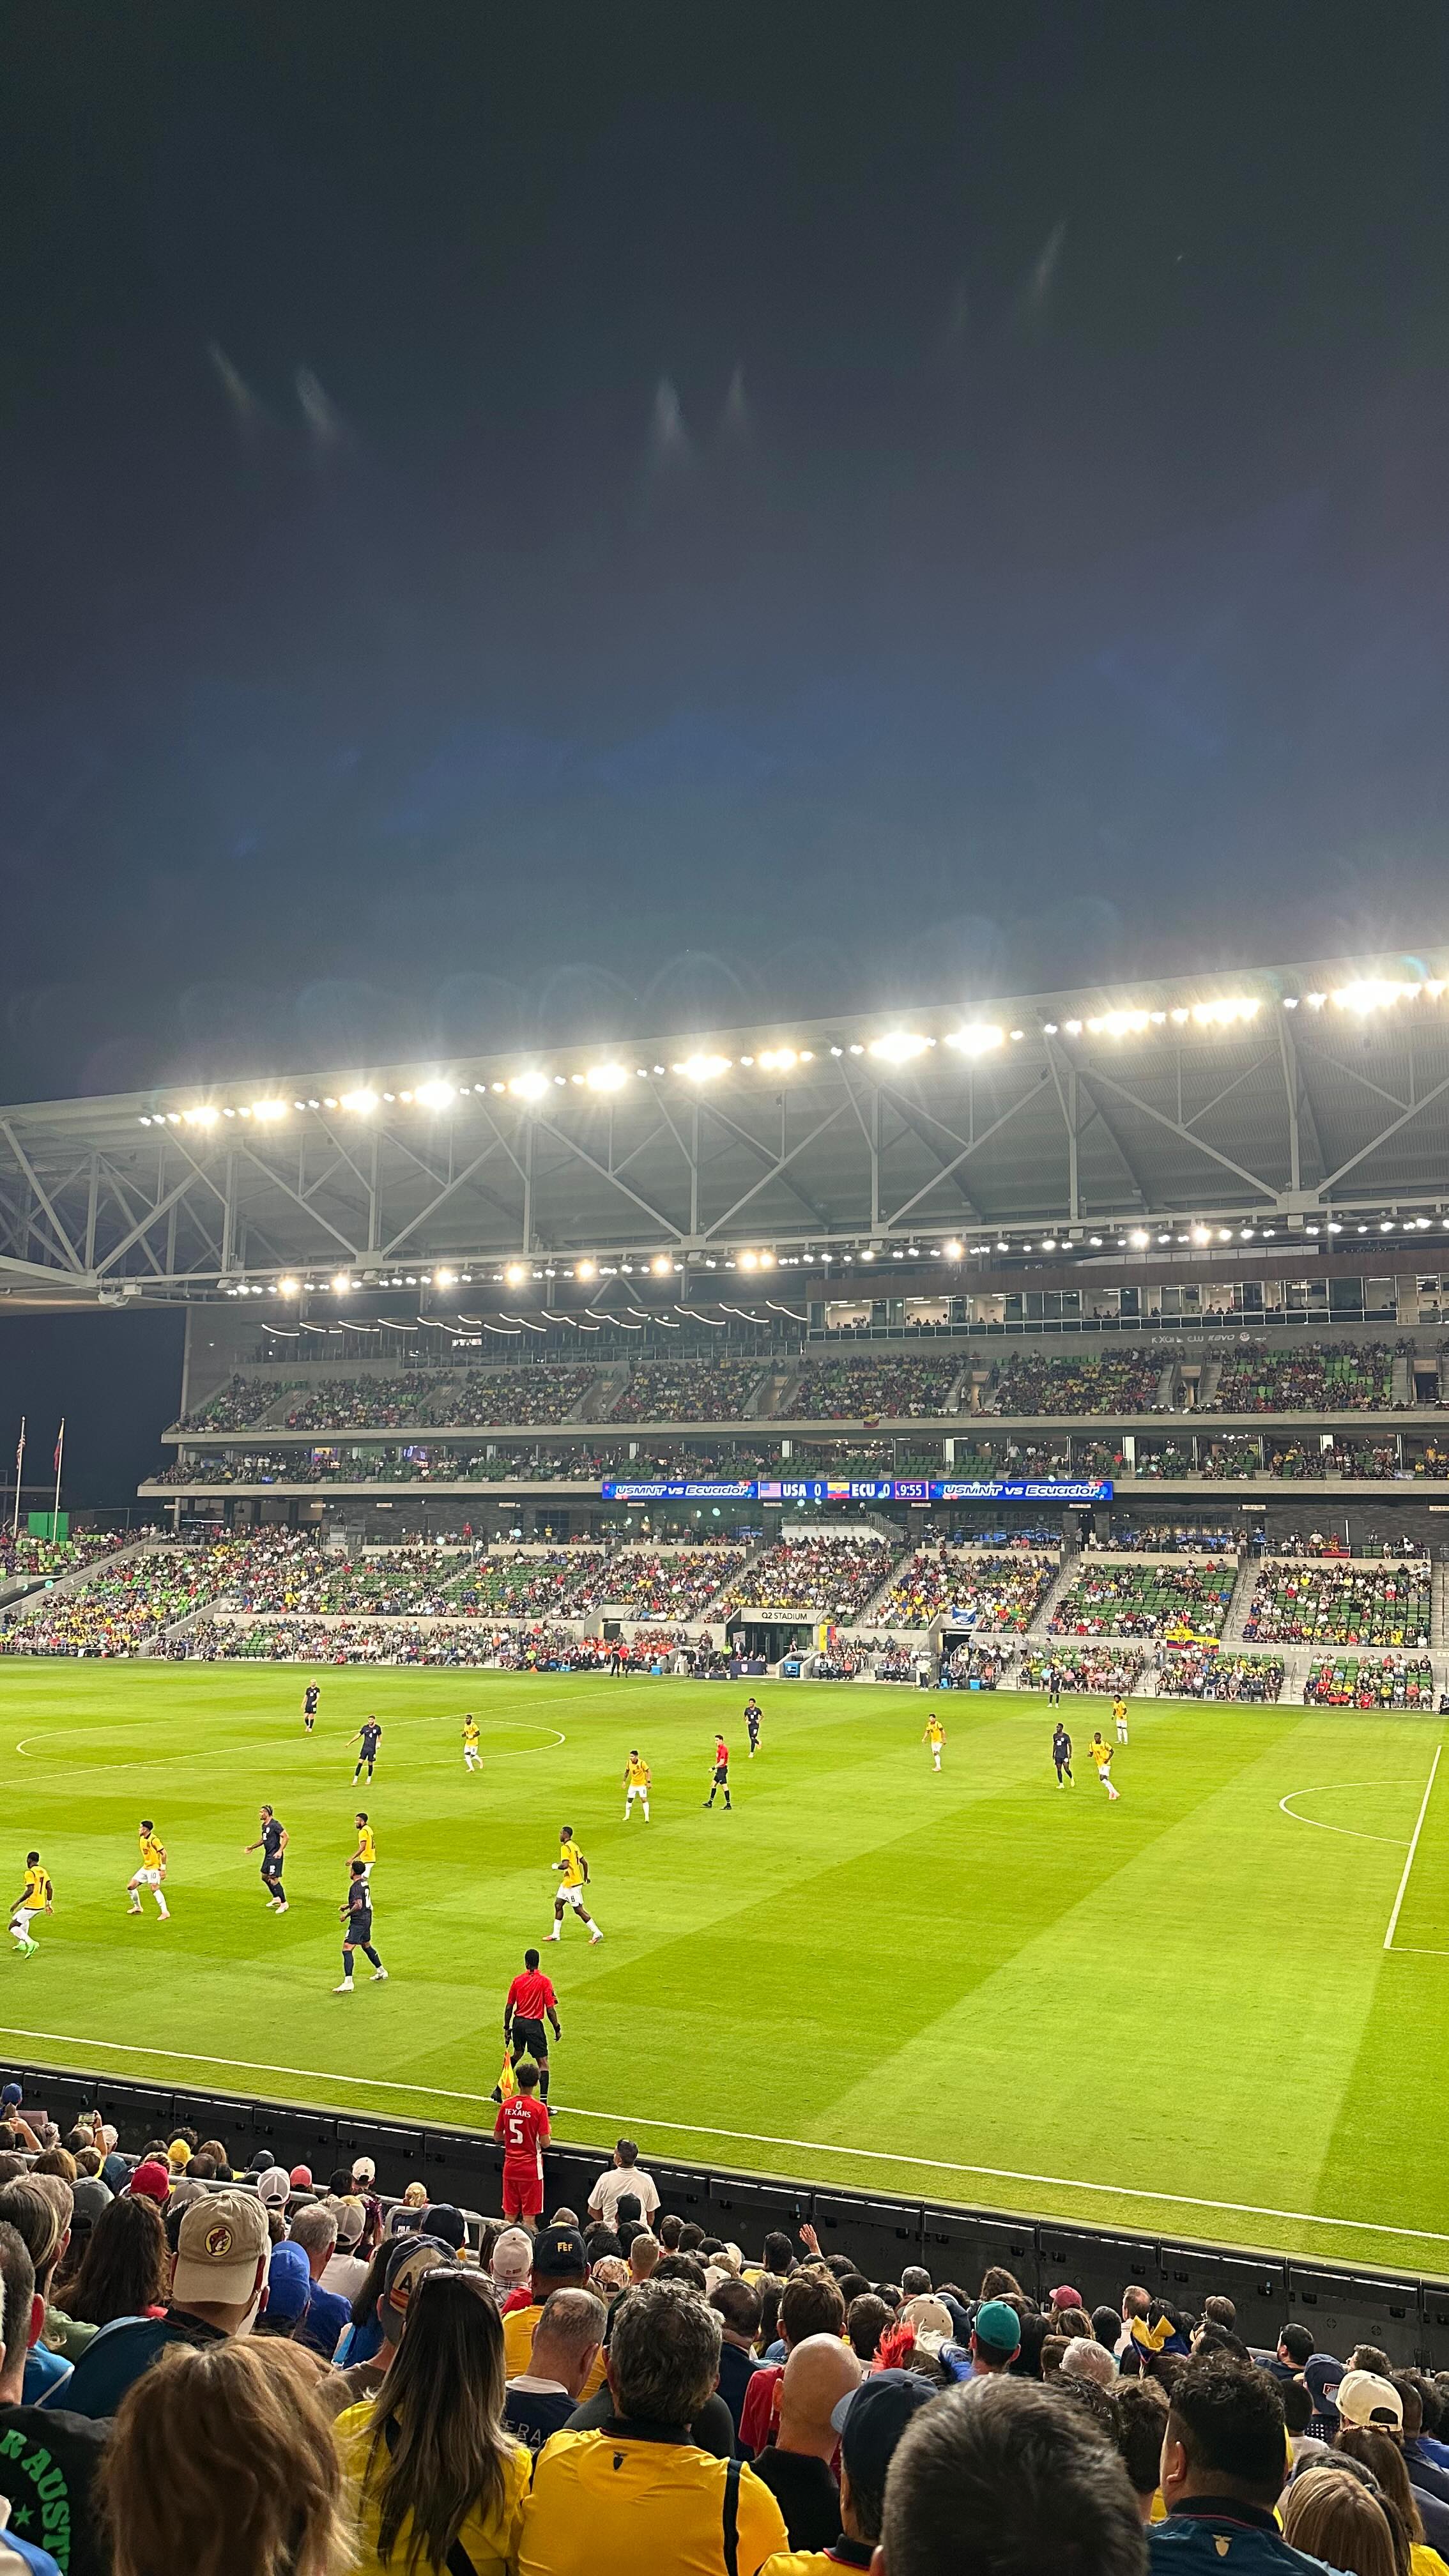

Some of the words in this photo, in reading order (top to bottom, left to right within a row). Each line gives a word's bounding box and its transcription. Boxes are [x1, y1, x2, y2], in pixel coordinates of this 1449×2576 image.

[616, 1485, 666, 1496] USMNT
[668, 1486, 684, 1495] vs
[686, 1484, 748, 1496] Ecuador
[783, 1483, 807, 1496] USA
[814, 1483, 822, 1496] 0
[852, 1483, 875, 1496] ECU
[882, 1483, 891, 1496] 0
[900, 1484, 922, 1496] 9:55
[944, 1484, 1002, 1496] USMNT
[1005, 1486, 1023, 1495] vs
[1026, 1484, 1099, 1497] Ecuador
[505, 2108, 532, 2118] TEXANS
[509, 2119, 524, 2144] 5
[557, 2242, 573, 2253] FEF
[398, 2271, 413, 2294] A
